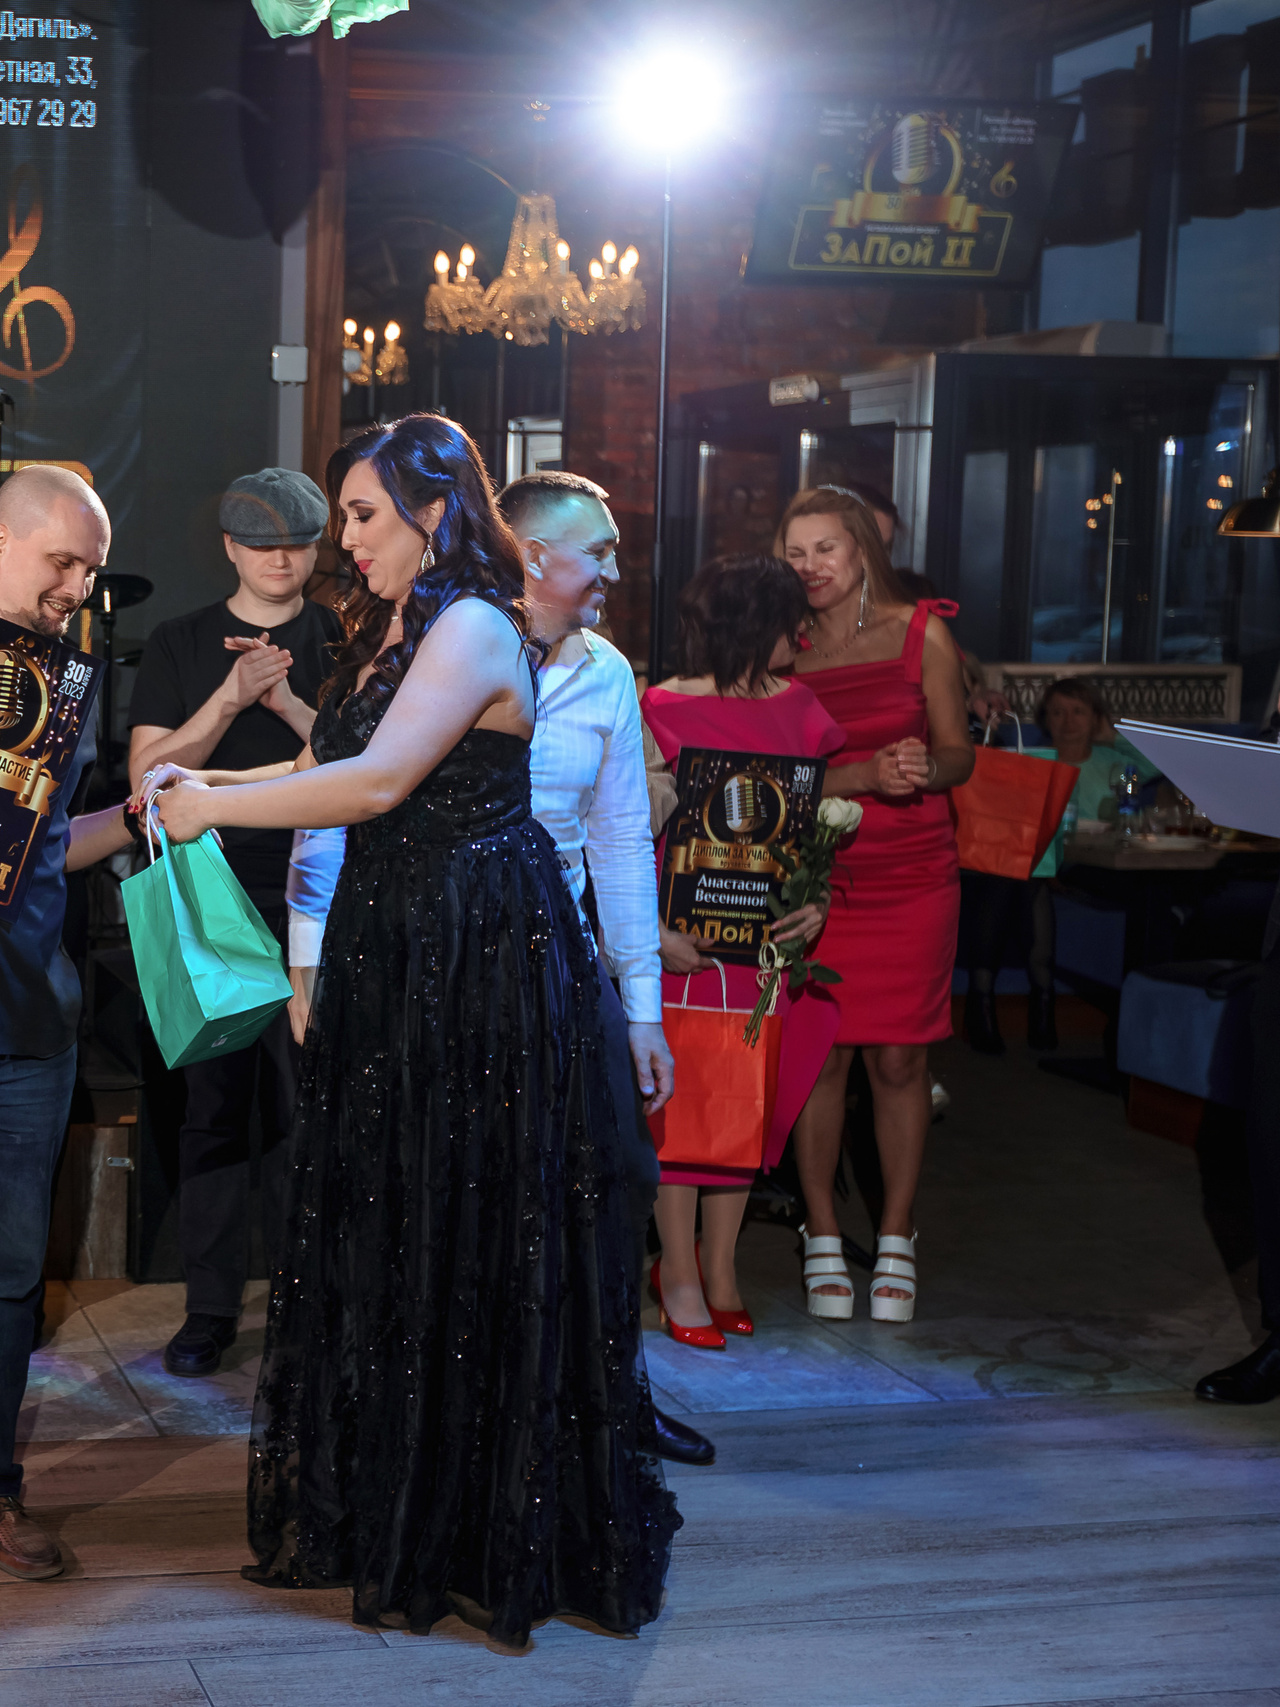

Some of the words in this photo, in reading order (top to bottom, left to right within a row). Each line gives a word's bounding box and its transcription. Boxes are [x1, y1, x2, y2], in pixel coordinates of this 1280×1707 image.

[65, 56, 98, 89] 33,
[37, 98, 65, 127] 29
[70, 99, 97, 128] 29
[63, 660, 86, 683] 30
[58, 679, 86, 700] 2023
[793, 764, 810, 782] 30
[693, 845, 730, 859] ДИПЛОМ
[732, 848, 743, 860] ЗА
[697, 873, 769, 893] Анастасии
[695, 888, 768, 907] Весениной
